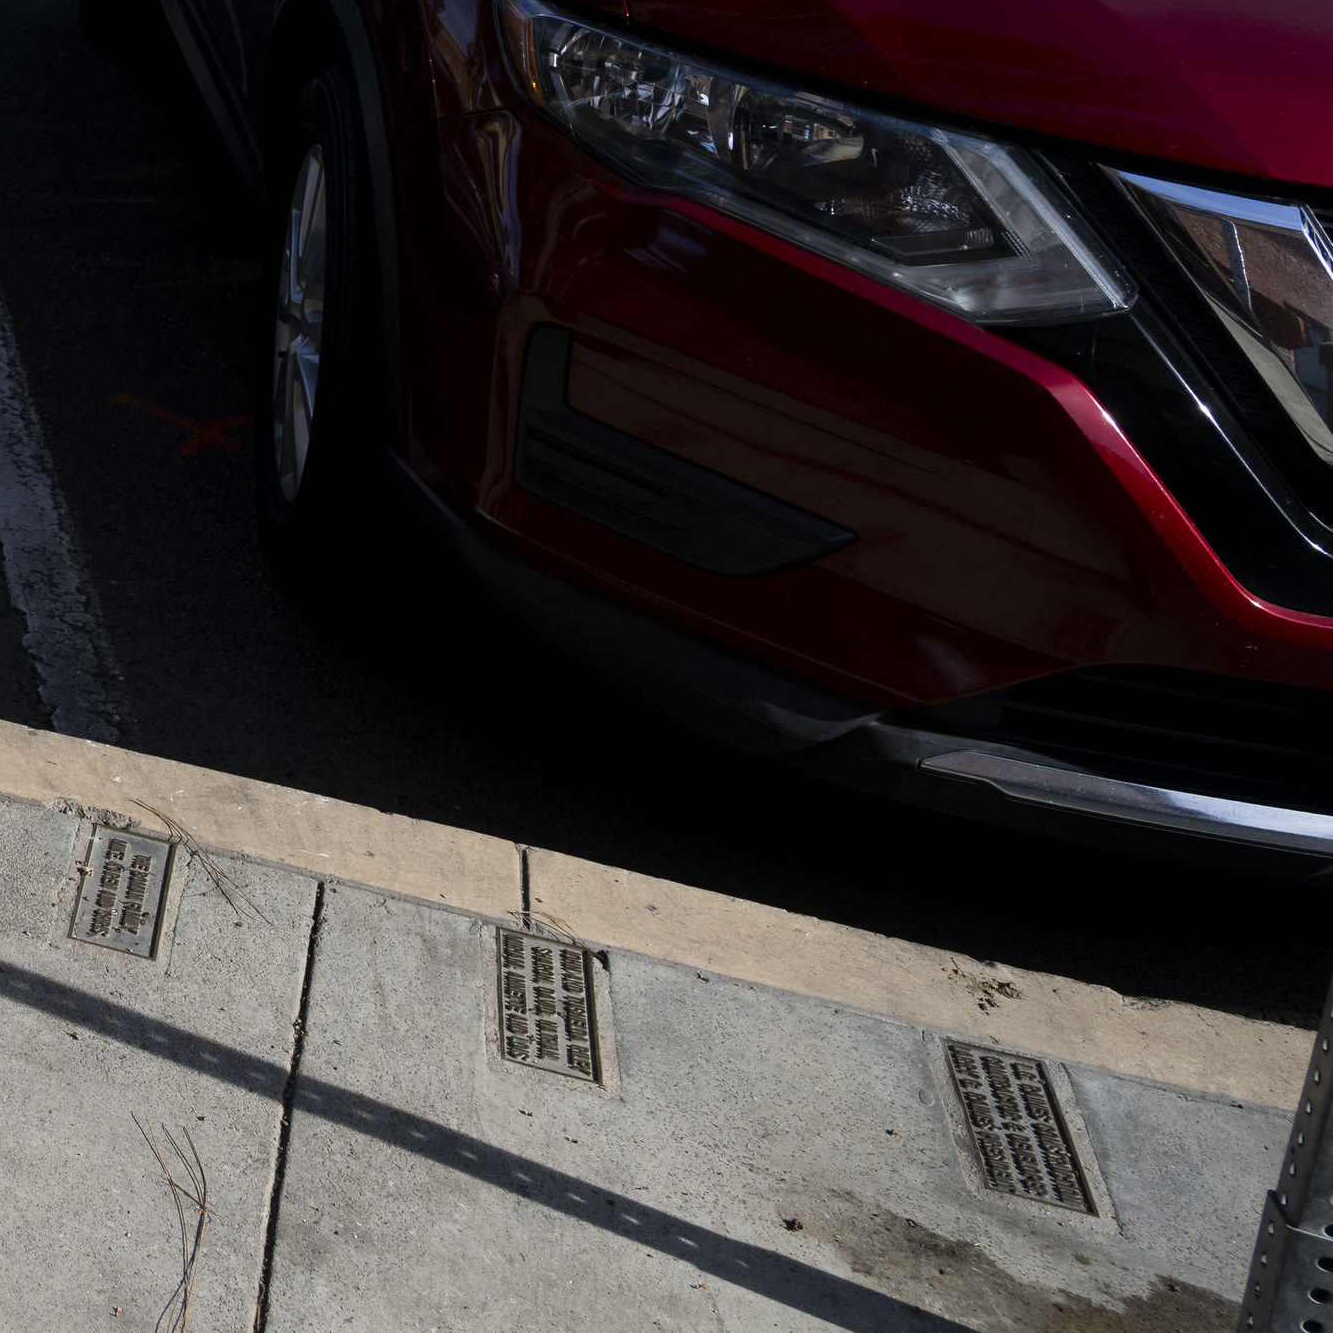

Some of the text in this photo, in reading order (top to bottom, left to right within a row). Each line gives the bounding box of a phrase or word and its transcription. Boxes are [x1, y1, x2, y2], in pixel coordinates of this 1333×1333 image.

[132, 853, 149, 870] THE
[95, 890, 115, 909] AND
[119, 901, 140, 933] FAMILY
[561, 949, 580, 974] JOHN
[505, 971, 525, 1013] ANNETTE
[563, 972, 582, 994] AND
[506, 1012, 526, 1036] AND
[507, 1035, 527, 1060] LOIS
[949, 1045, 979, 1078] LARRY
[1018, 1083, 1052, 1123] RAINES
[980, 1055, 1046, 1197] CONTRACTOR & DEVELOPER
[1031, 1122, 1081, 1206] CONSTRUCTION
